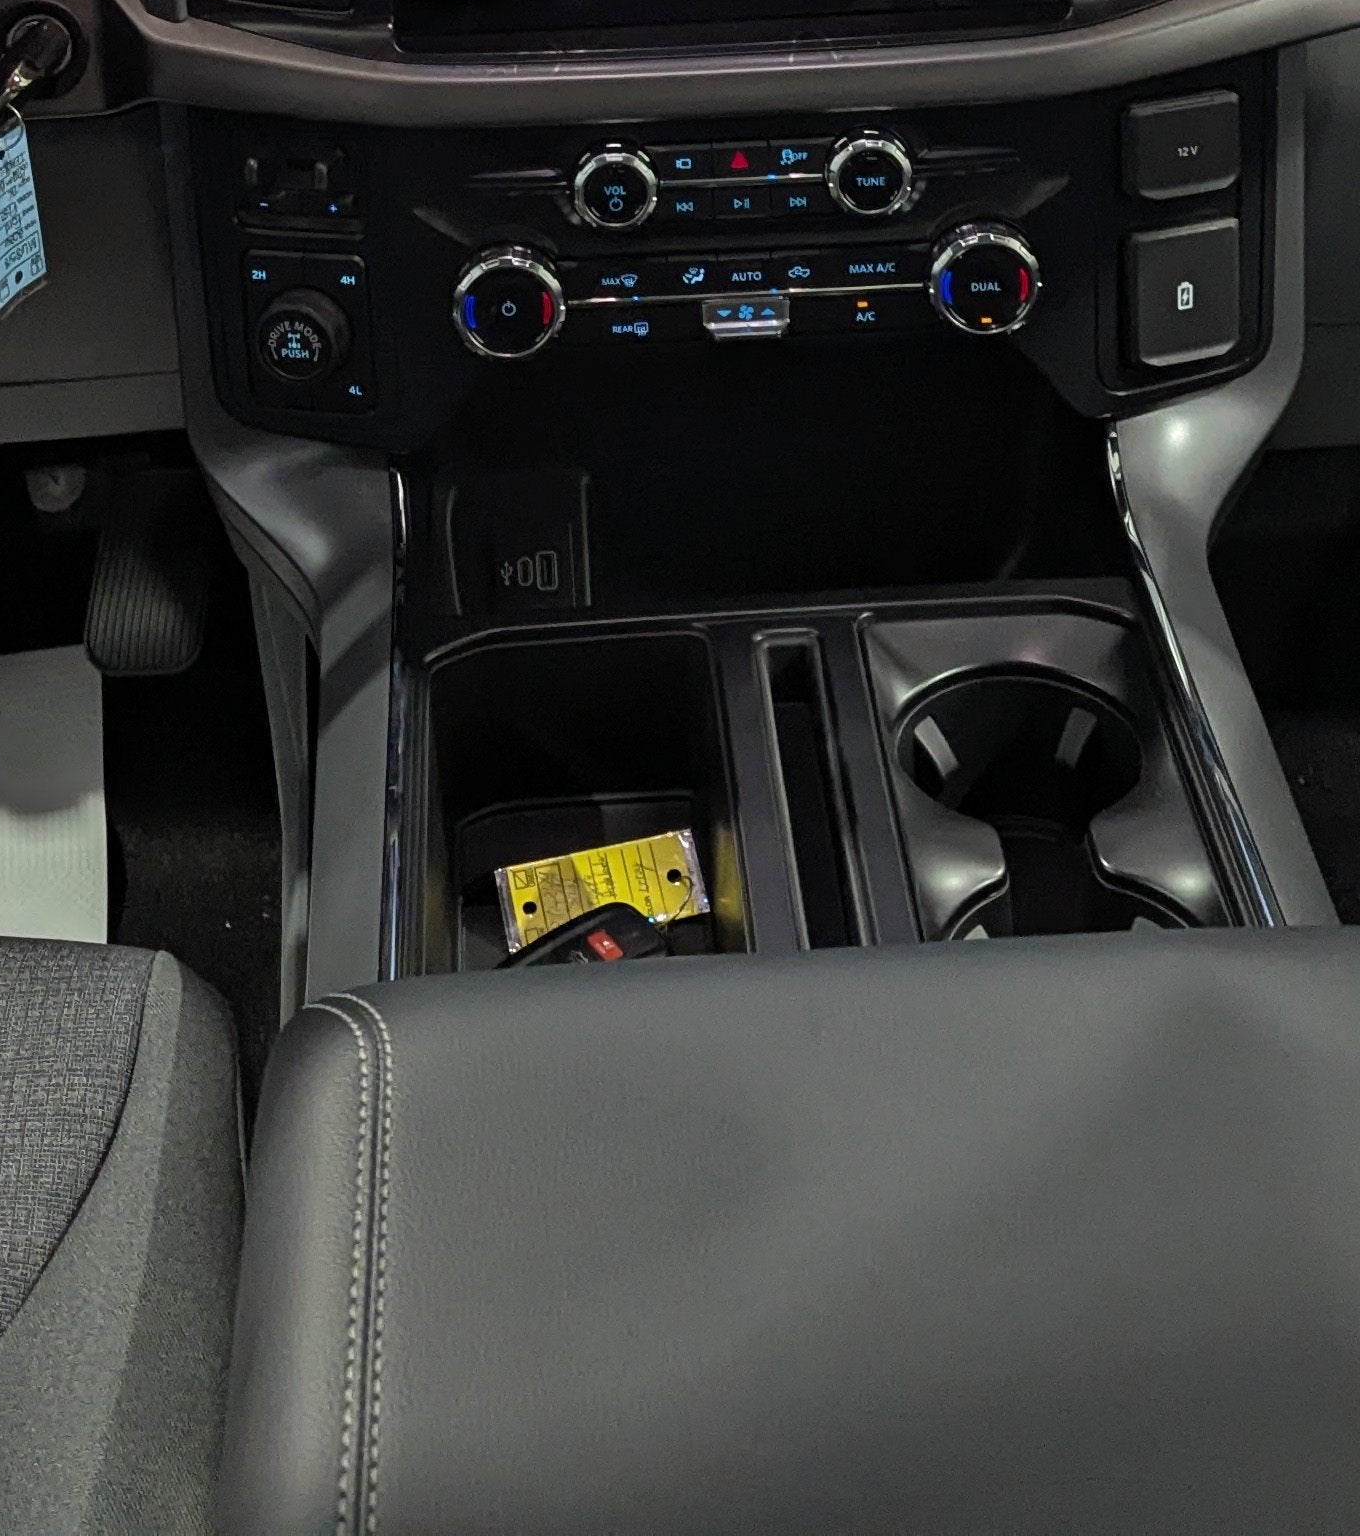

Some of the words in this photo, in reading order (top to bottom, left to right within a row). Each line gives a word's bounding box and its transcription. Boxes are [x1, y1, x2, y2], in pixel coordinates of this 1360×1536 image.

[1177, 147, 1189, 157] 12
[1190, 145, 1199, 156] V
[856, 177, 886, 187] TUNE
[603, 185, 626, 196] VOL
[849, 264, 874, 274] MAX
[876, 262, 896, 273] A/C
[251, 269, 266, 280] 2H
[731, 271, 762, 282] AUTO
[340, 275, 356, 286] 4H
[970, 282, 1001, 292] DUAL
[856, 312, 876, 322] A/C
[612, 324, 633, 334] REAR
[268, 321, 292, 347] DRIVE
[294, 321, 322, 350] MODE
[281, 348, 310, 359] PUSH
[348, 385, 363, 396] 4L
